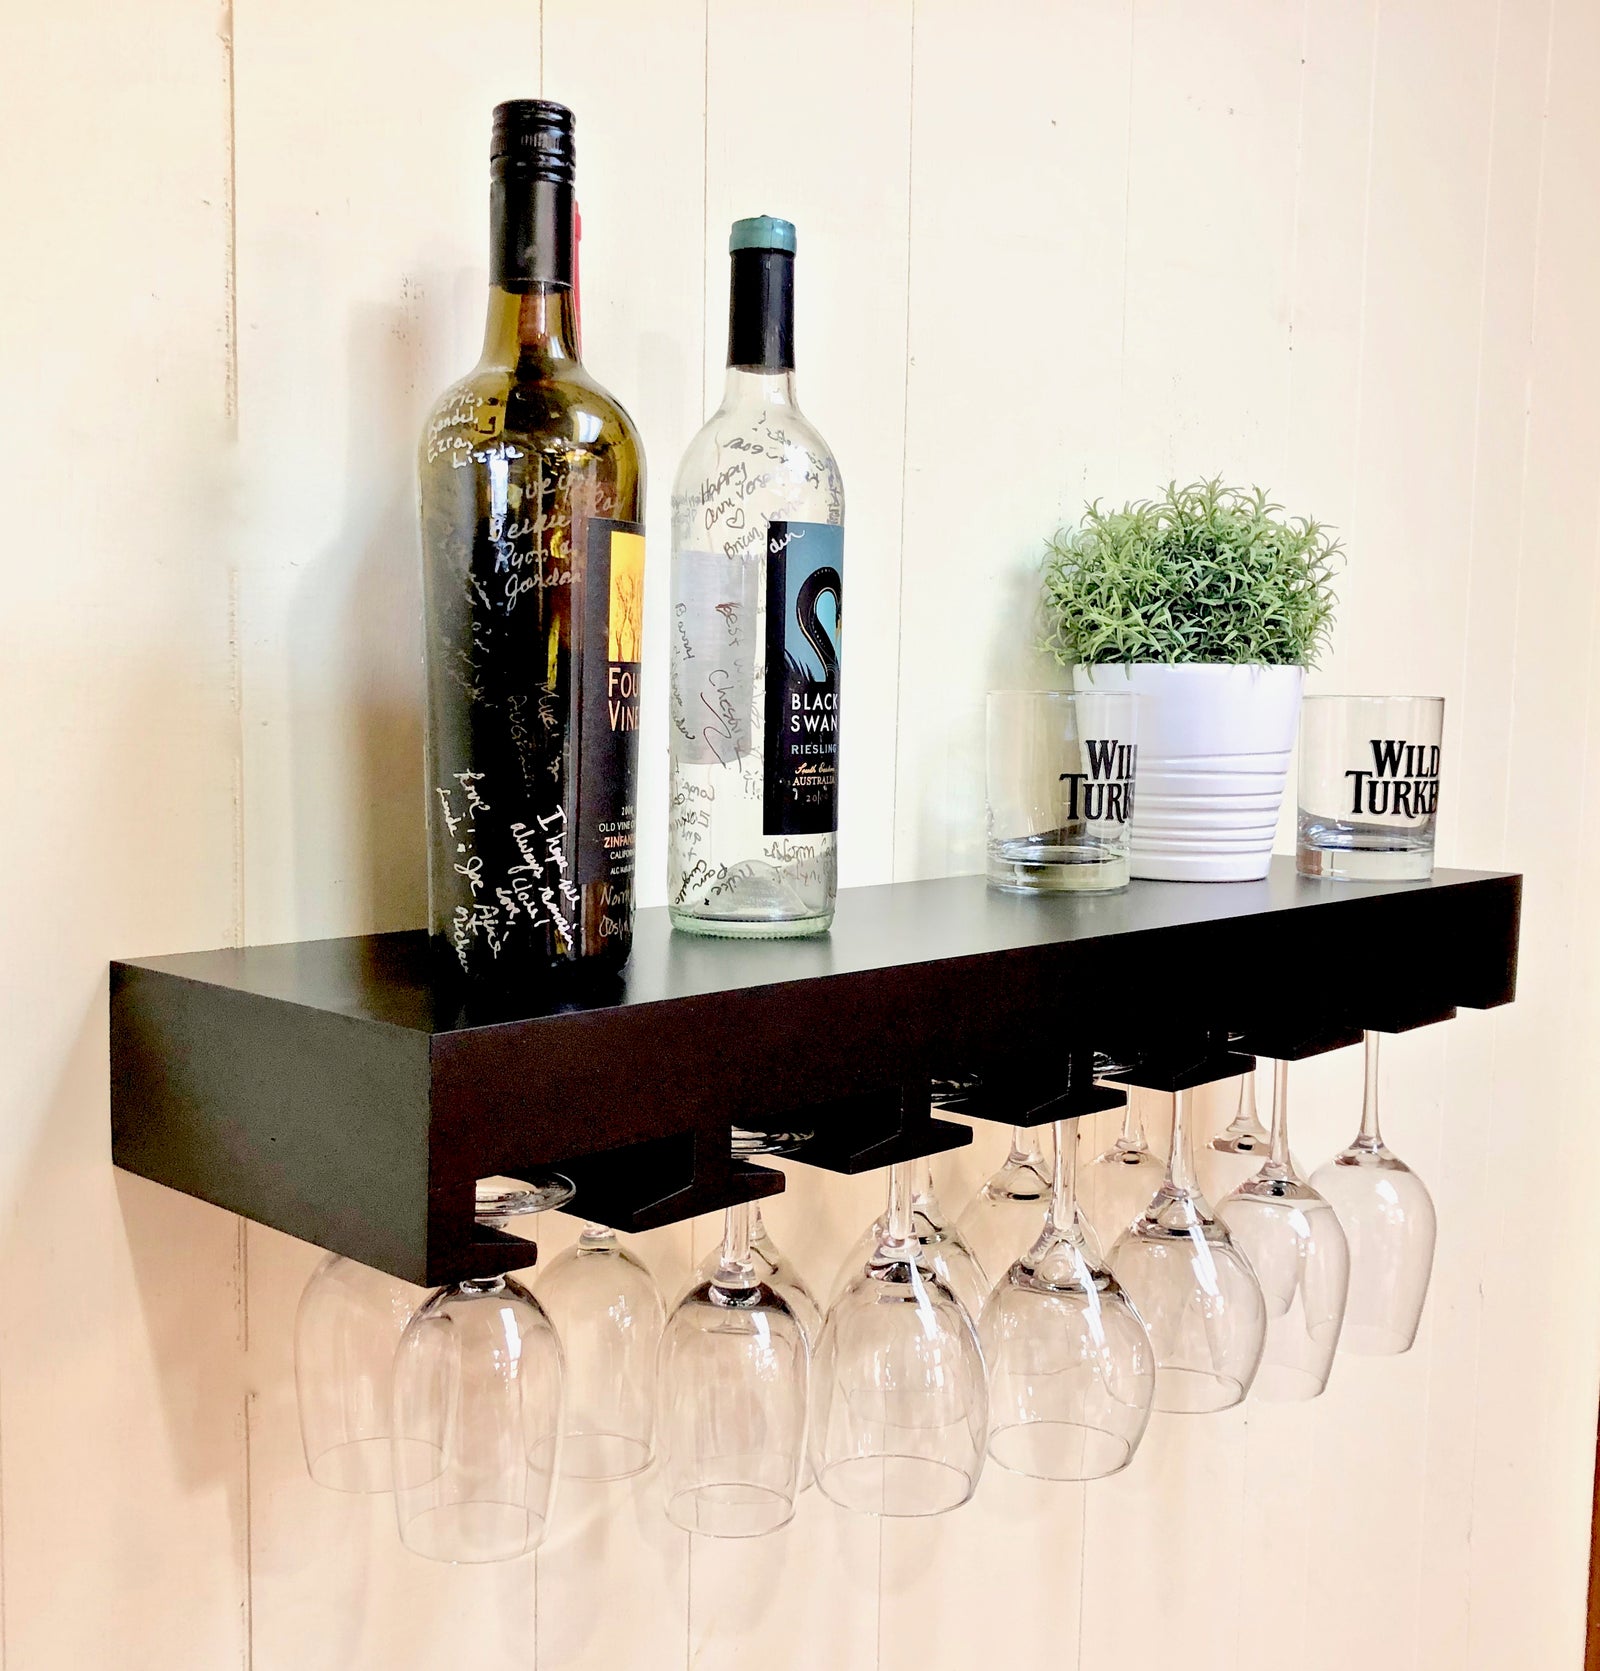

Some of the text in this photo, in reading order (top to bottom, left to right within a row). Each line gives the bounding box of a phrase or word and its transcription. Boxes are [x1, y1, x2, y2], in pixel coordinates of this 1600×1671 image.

[701, 461, 748, 505] Happy
[791, 692, 839, 711] BLACK
[790, 714, 839, 733] SWAN
[791, 743, 838, 755] RIESLING
[1369, 739, 1440, 778] WILD
[536, 804, 568, 832] I
[599, 822, 616, 833] OLD
[544, 830, 569, 875] hope
